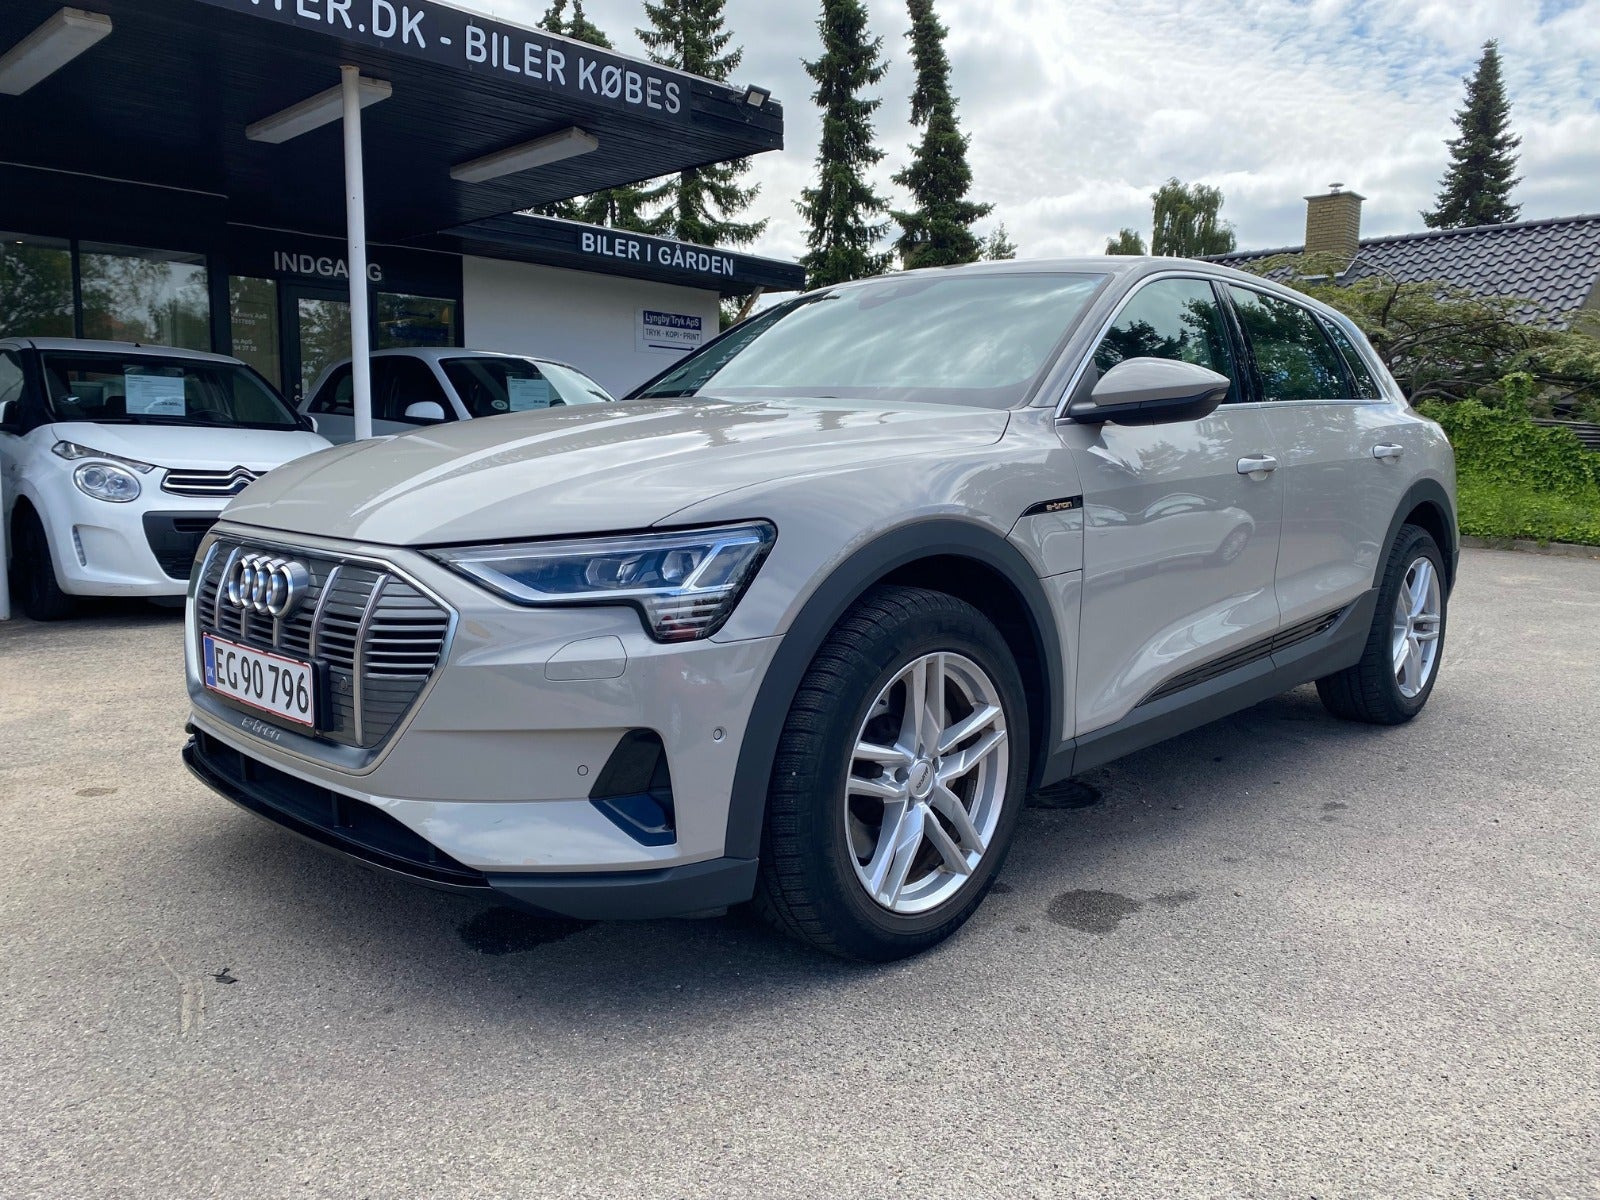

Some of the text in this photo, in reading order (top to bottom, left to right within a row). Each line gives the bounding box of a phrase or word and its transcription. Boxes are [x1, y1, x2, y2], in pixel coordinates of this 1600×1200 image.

[465, 25, 565, 86] BILER
[578, 57, 681, 114] KØBES
[273, 251, 382, 281] INDGAG
[582, 232, 734, 276] BILER I GÅRDEN
[645, 312, 700, 328] Lyngby Tryk ApS
[646, 328, 662, 337] TRYK
[683, 332, 700, 341] PRINT
